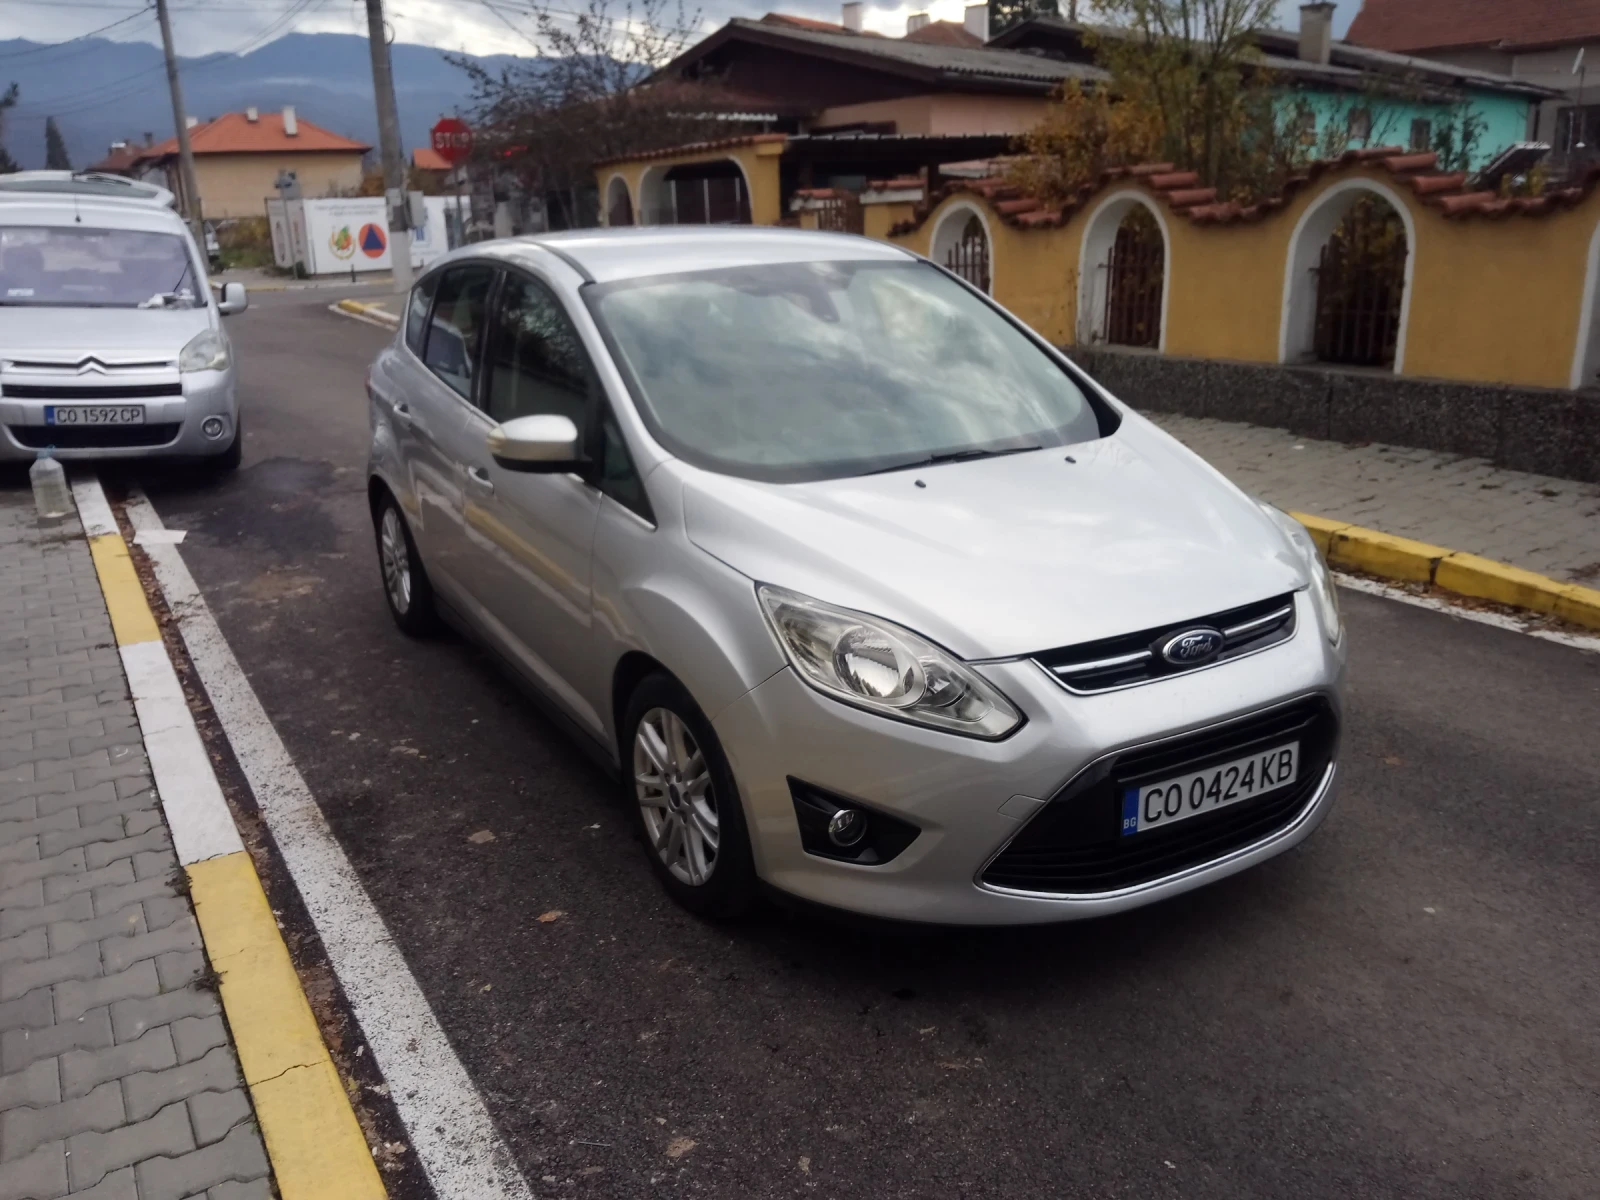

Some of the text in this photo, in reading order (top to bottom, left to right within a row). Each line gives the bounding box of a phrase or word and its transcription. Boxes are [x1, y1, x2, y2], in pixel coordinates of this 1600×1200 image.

[82, 408, 119, 423] 1592
[1180, 635, 1213, 658] Ford
[1144, 749, 1293, 823] CO 0424 KB
[1123, 817, 1137, 829] BG
